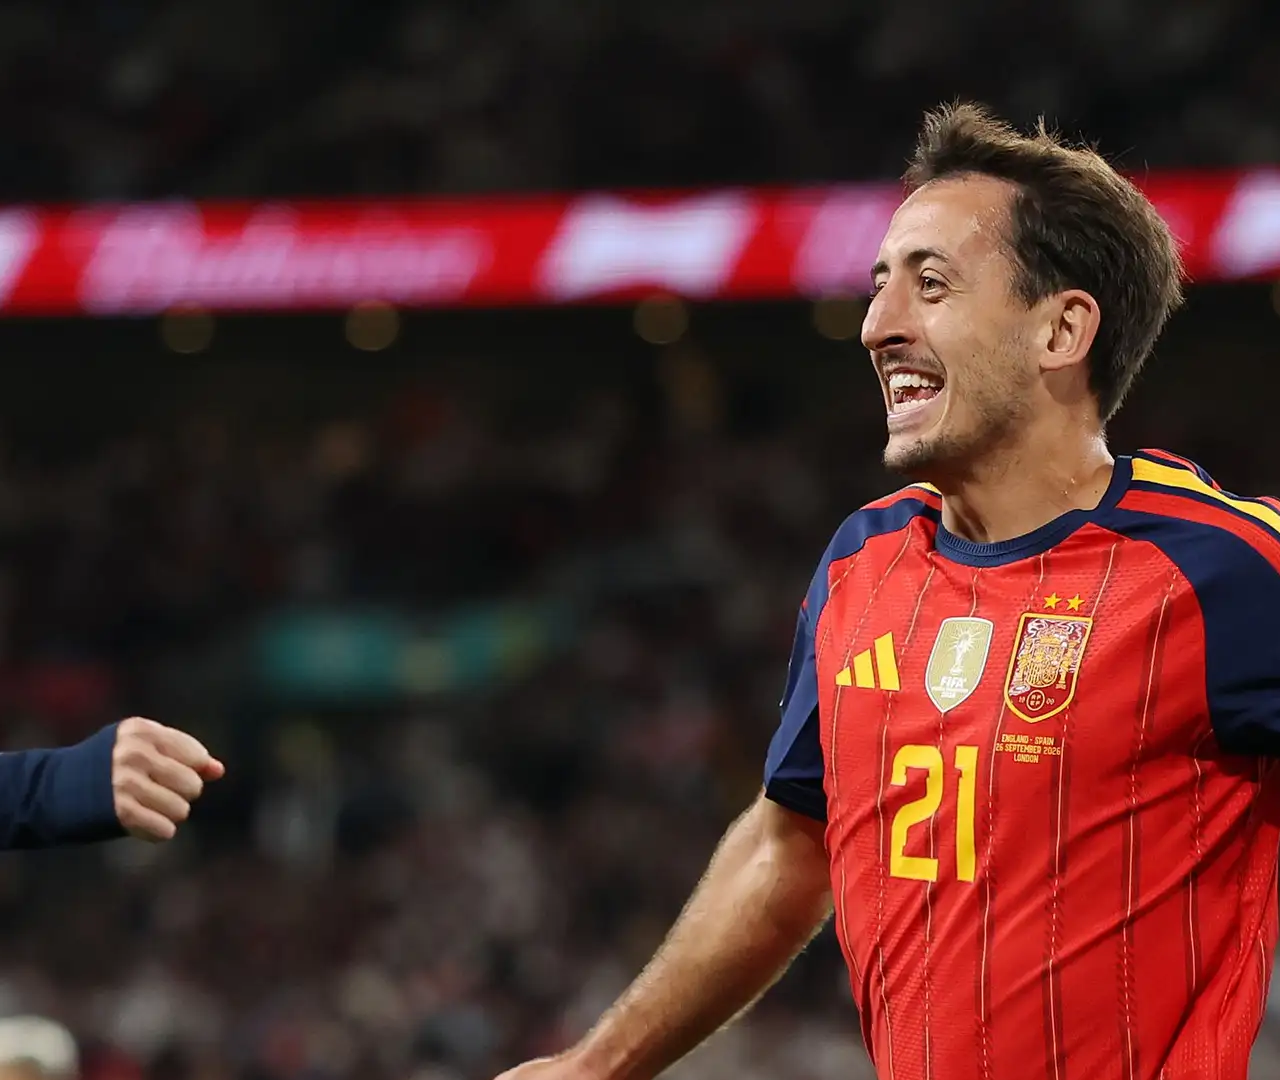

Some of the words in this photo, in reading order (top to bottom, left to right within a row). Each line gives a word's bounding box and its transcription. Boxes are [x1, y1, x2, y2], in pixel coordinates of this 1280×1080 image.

[940, 676, 965, 689] FIFA
[1001, 733, 1029, 744] ENGLAND
[1034, 736, 1055, 746] SPAIN
[995, 743, 1004, 752] 26
[1004, 743, 1042, 754] SEPTEMBER
[1043, 746, 1061, 756] 2026
[1013, 753, 1039, 764] LONDON
[889, 744, 979, 883] 21
